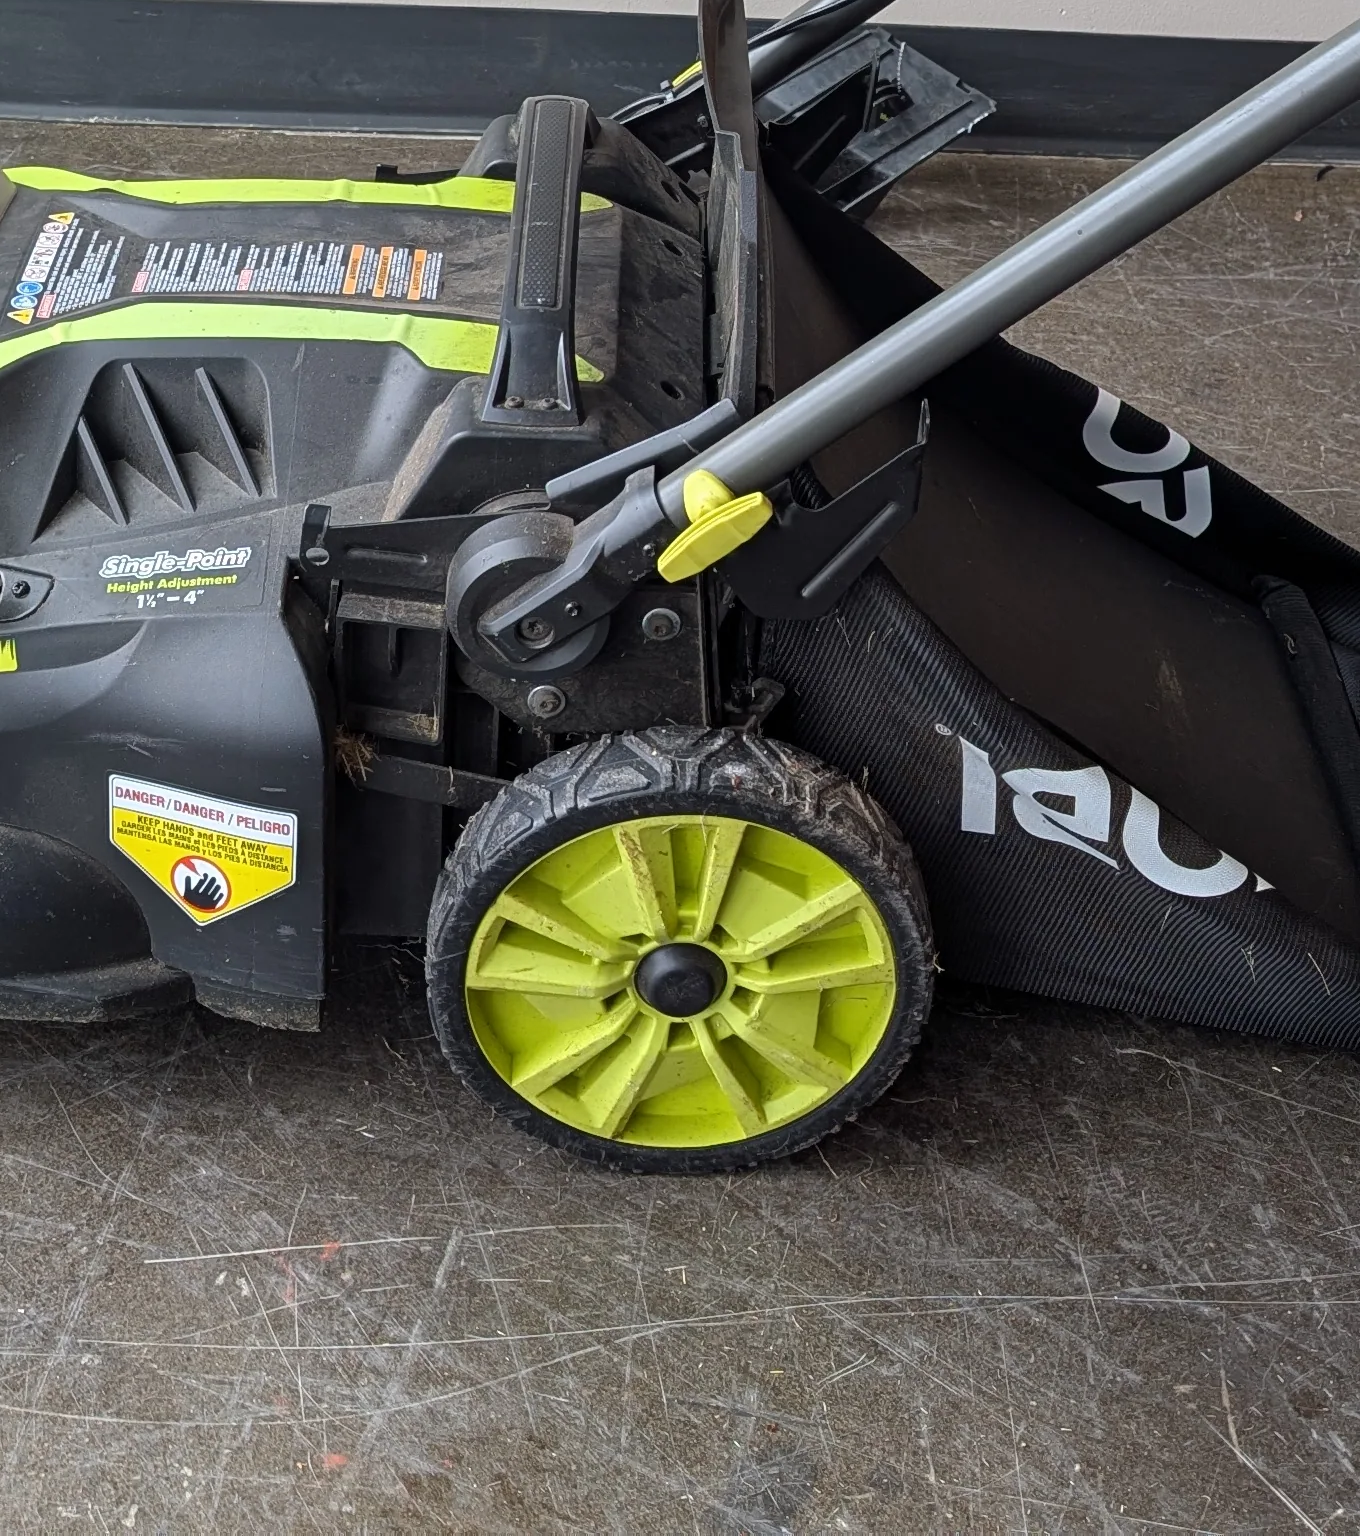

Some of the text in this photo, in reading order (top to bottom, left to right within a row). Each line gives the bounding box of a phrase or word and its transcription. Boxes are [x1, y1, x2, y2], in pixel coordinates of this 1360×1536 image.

[101, 547, 251, 578] Single-Point
[106, 574, 238, 594] Height Adjustment
[115, 785, 166, 808] DANGER
[173, 799, 225, 824] DANGER
[236, 814, 291, 836] PELIGRO
[138, 814, 268, 854] KEEP HANDS and FEET AWAY
[247, 851, 285, 865] DISTANCE
